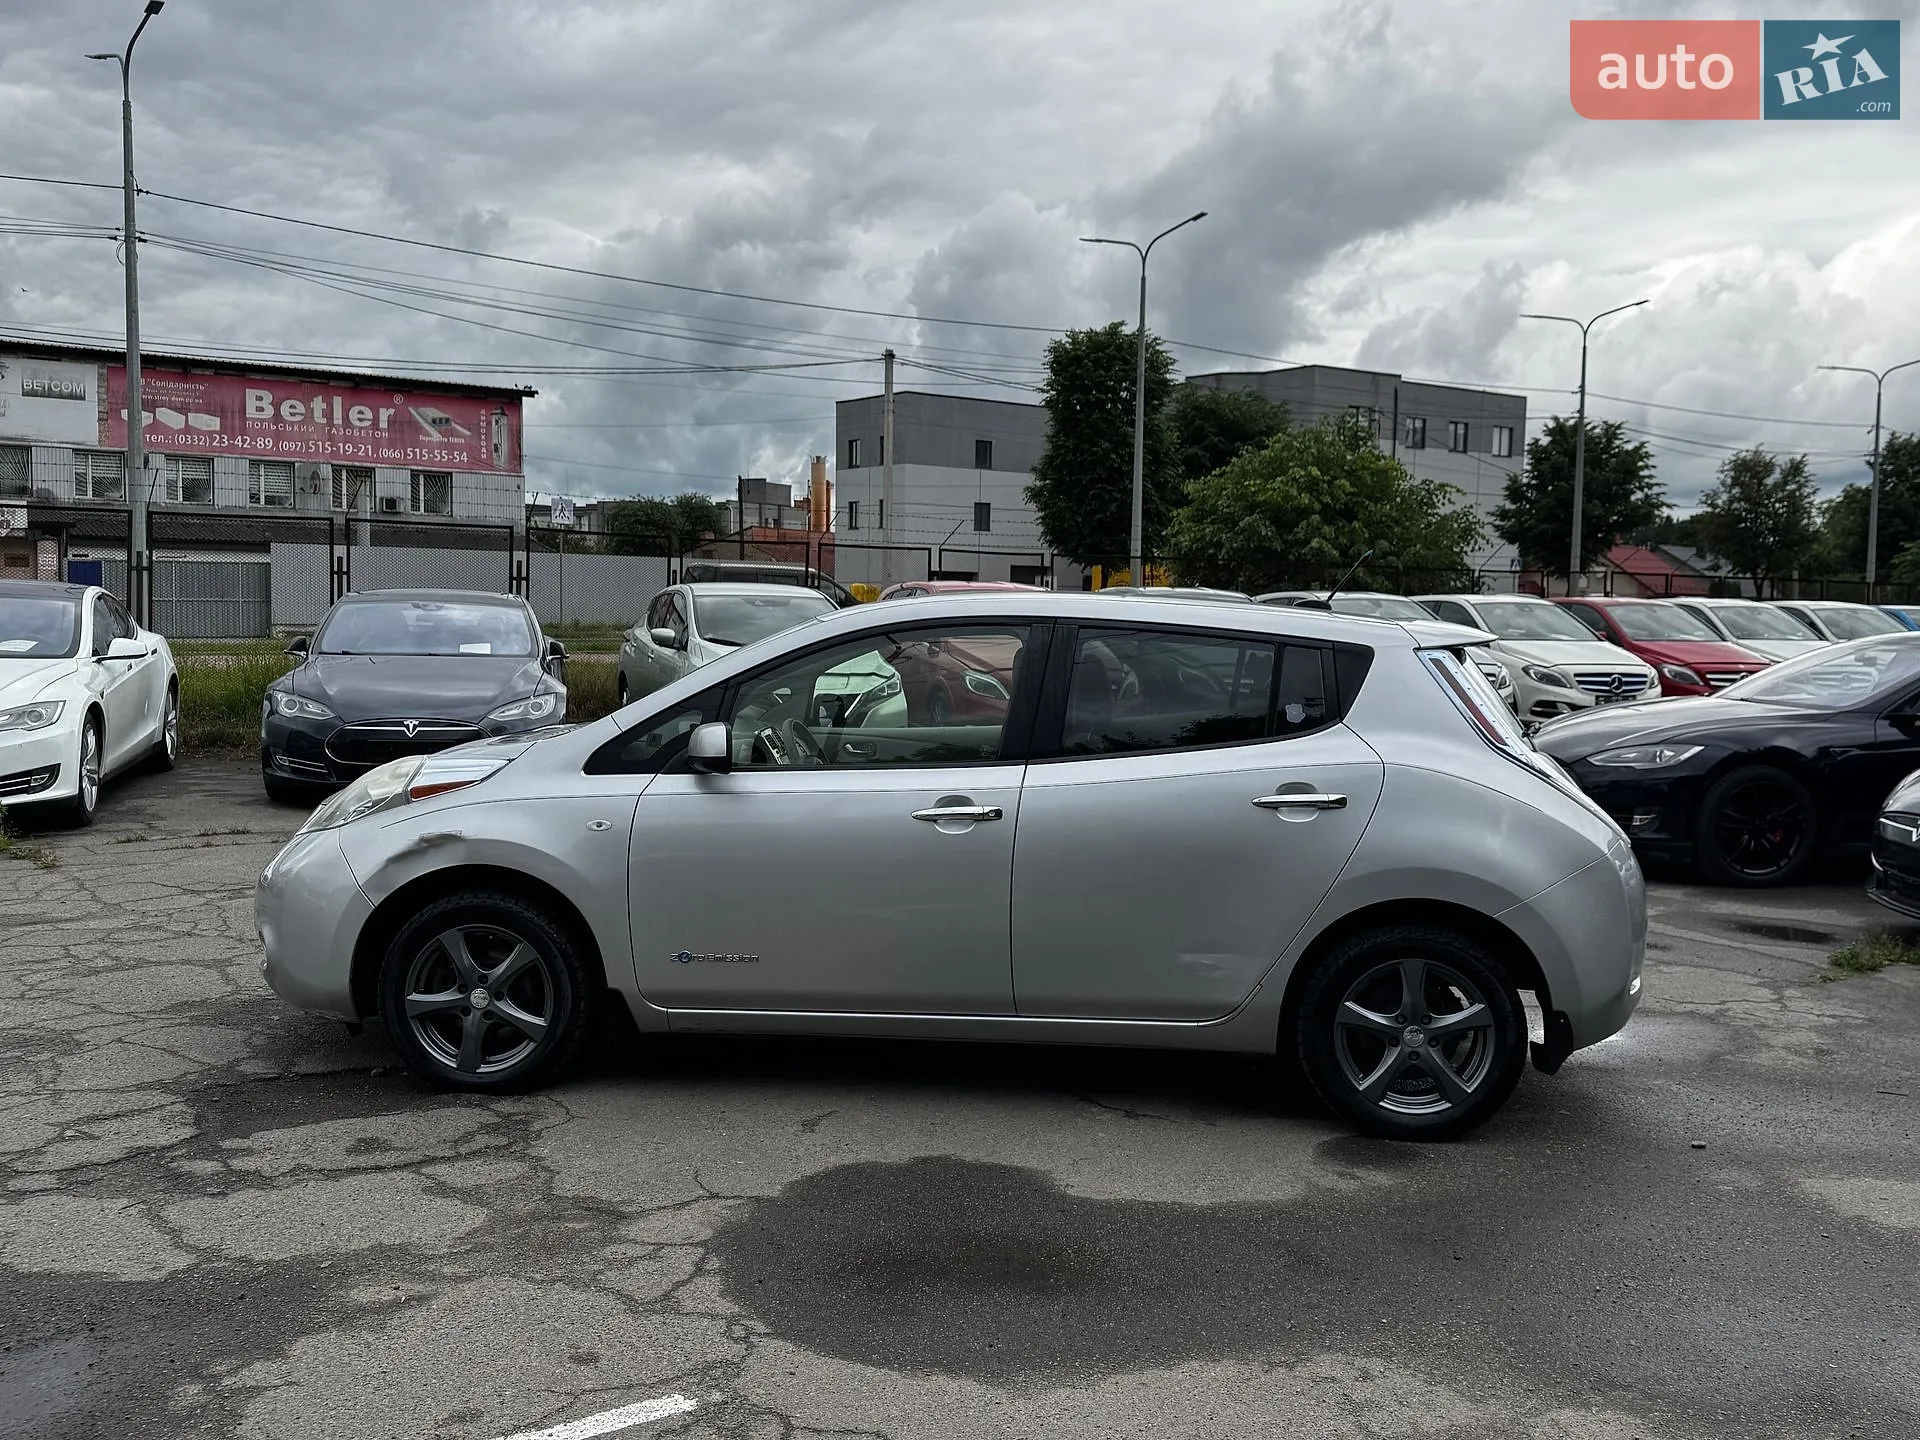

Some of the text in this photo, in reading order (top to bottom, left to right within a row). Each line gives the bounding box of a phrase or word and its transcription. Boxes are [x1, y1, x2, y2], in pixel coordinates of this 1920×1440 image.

[23, 378, 85, 394] BETCOM
[245, 388, 396, 429] Betler
[325, 427, 389, 439] ГАЗОБЕТОН
[144, 432, 173, 444] тел.:
[174, 434, 210, 447] (0332)
[278, 440, 306, 453] (097)
[379, 447, 404, 460] (066)
[406, 447, 468, 463] 515-55-54
